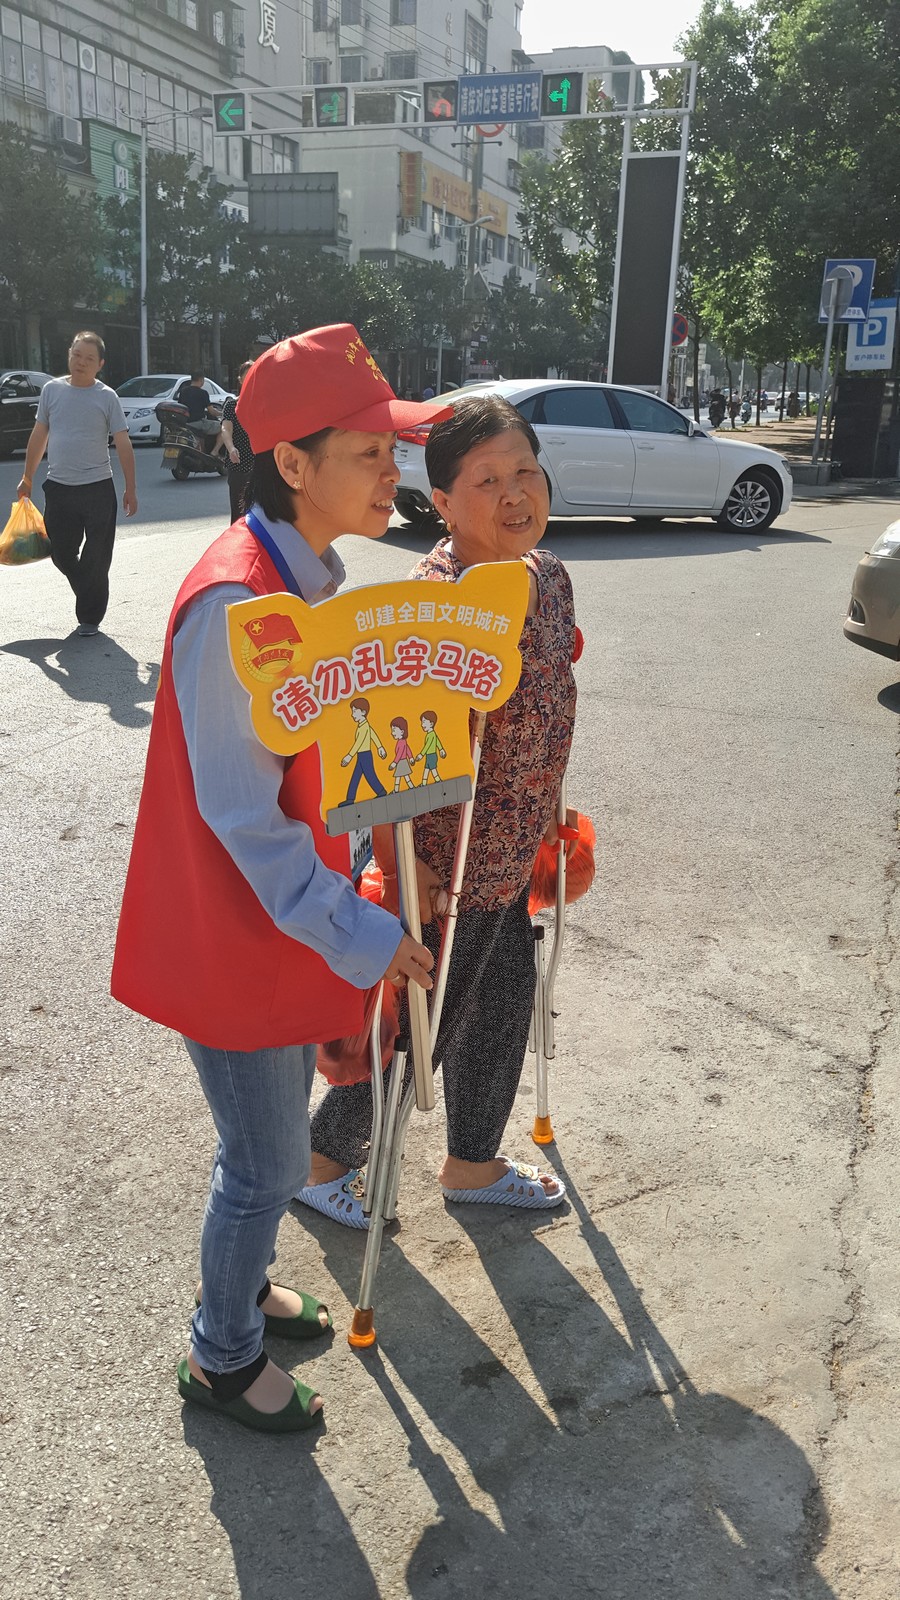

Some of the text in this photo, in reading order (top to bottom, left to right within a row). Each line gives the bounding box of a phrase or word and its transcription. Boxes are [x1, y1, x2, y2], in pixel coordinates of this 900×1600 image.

[259, 0, 280, 53] 厦
[461, 83, 539, 116] 请按对应车道信号行驶
[862, 319, 883, 346] P
[354, 601, 511, 635] 创建全国文明城市
[273, 636, 502, 731] 请勿乱穿马路
